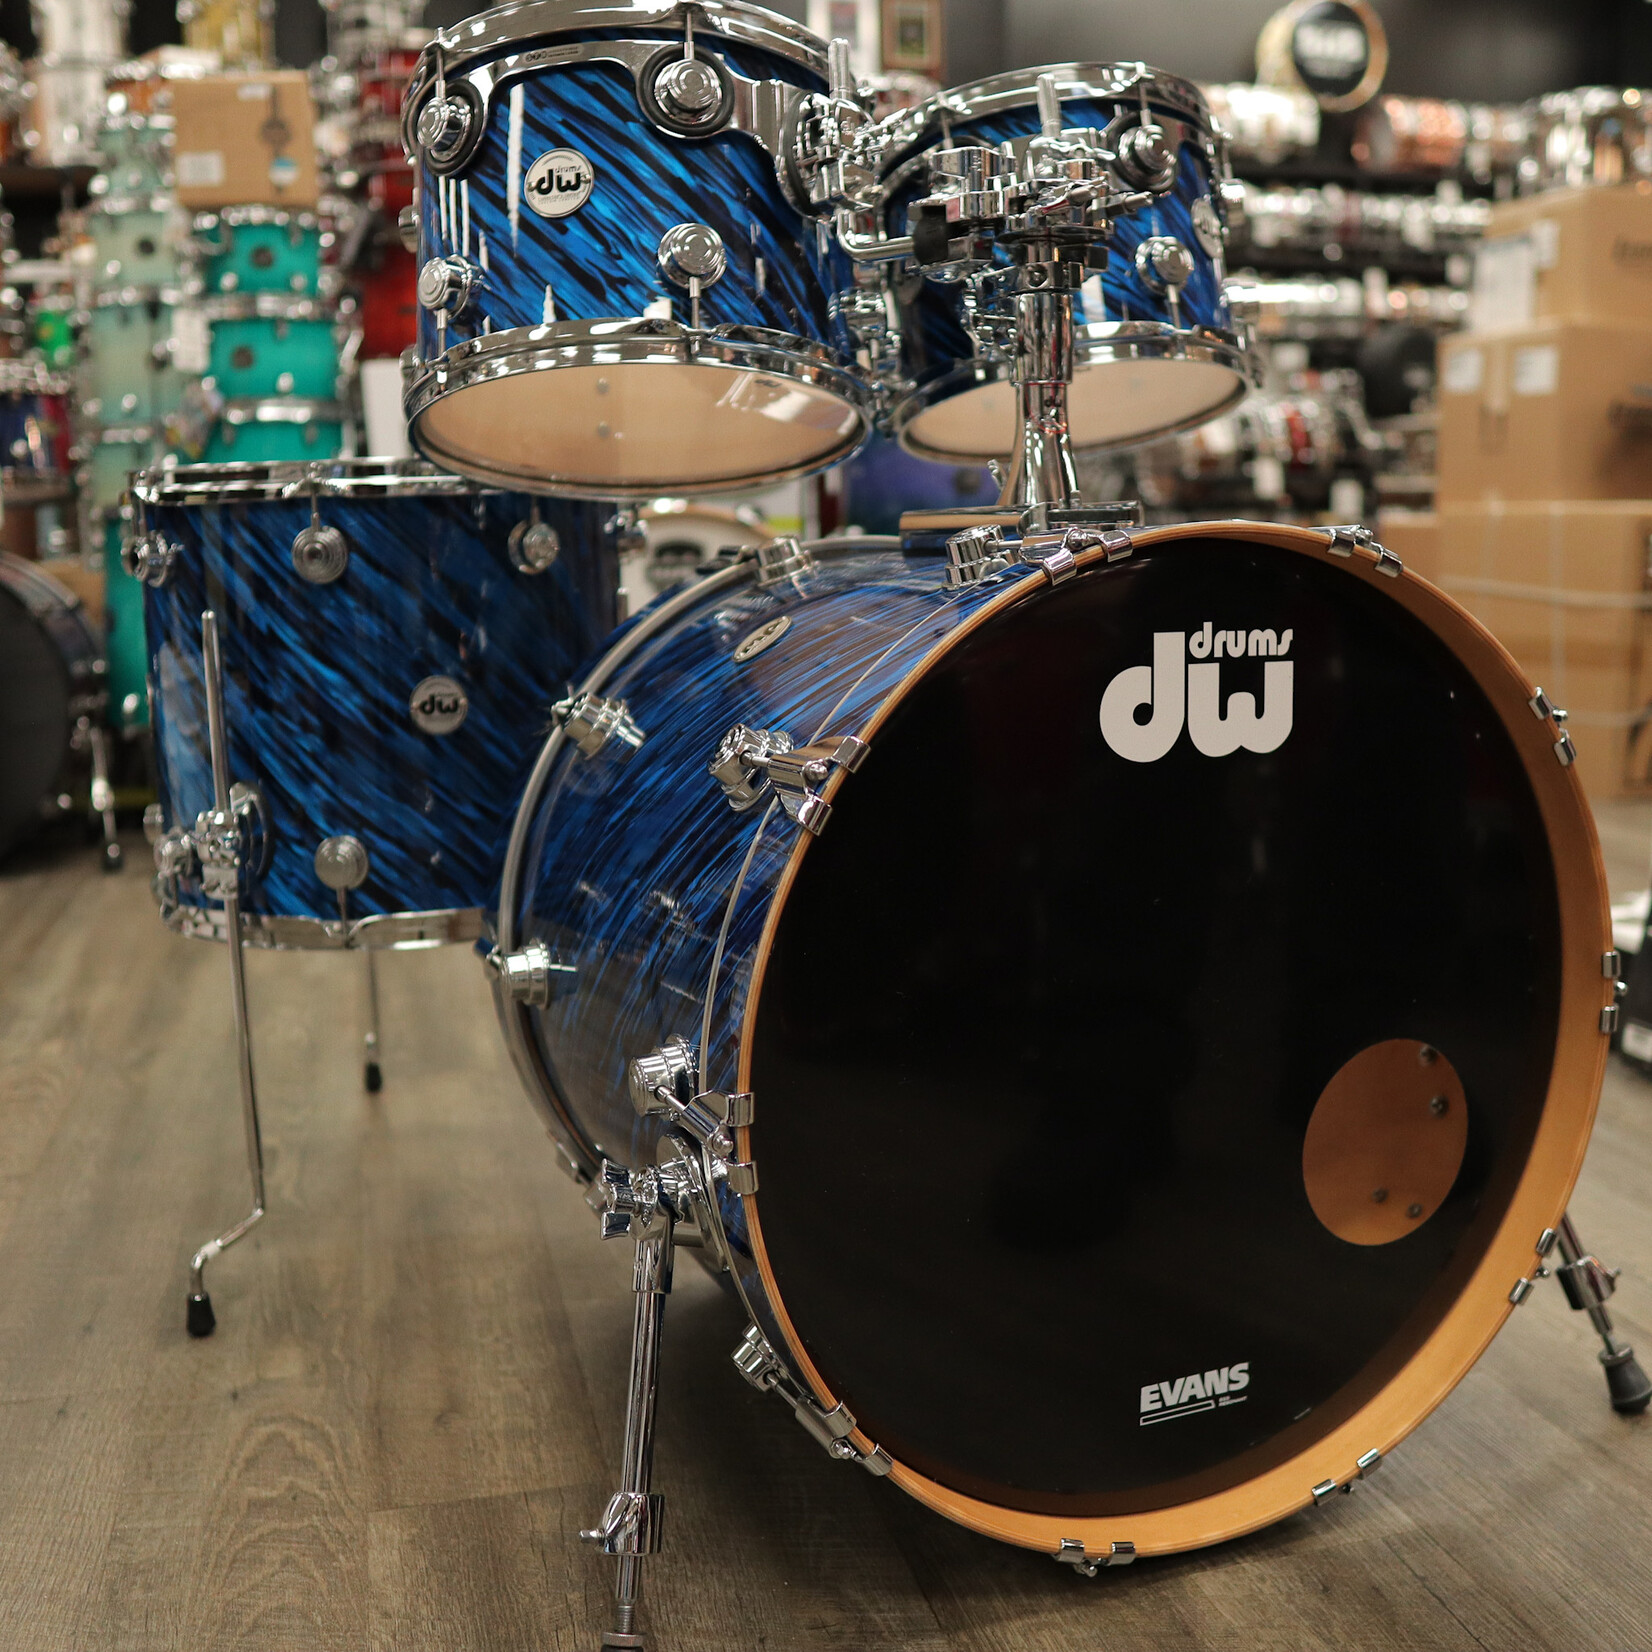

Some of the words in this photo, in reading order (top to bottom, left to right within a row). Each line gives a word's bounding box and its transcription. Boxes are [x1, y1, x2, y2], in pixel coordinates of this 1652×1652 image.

[536, 168, 581, 195] dw
[1188, 621, 1294, 659] drums
[420, 694, 459, 715] dw
[1099, 631, 1294, 763] dw
[1140, 1362, 1250, 1413] EVANS
